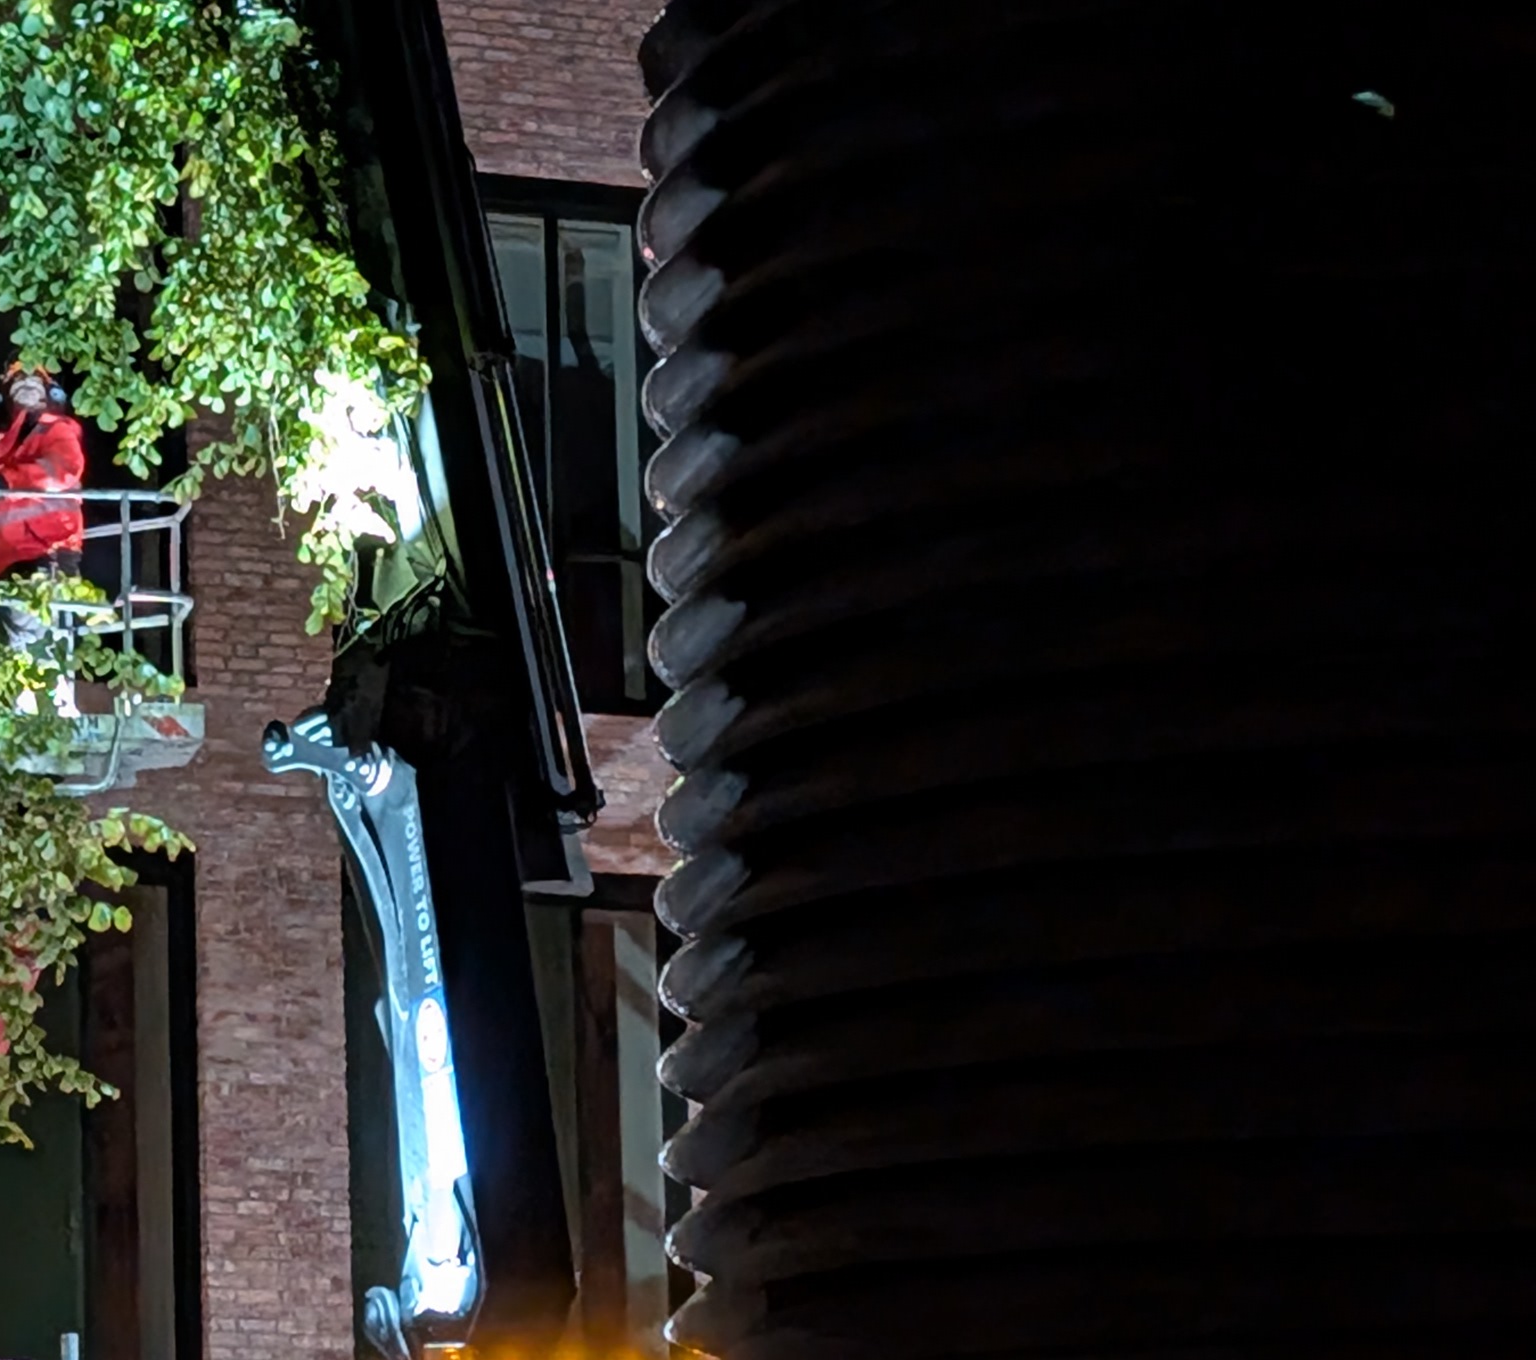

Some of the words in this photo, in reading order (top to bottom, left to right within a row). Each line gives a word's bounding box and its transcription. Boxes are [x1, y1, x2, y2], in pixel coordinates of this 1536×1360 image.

[403, 806, 424, 894] POWER
[416, 895, 430, 931] TO
[420, 935, 438, 985] LIFT
